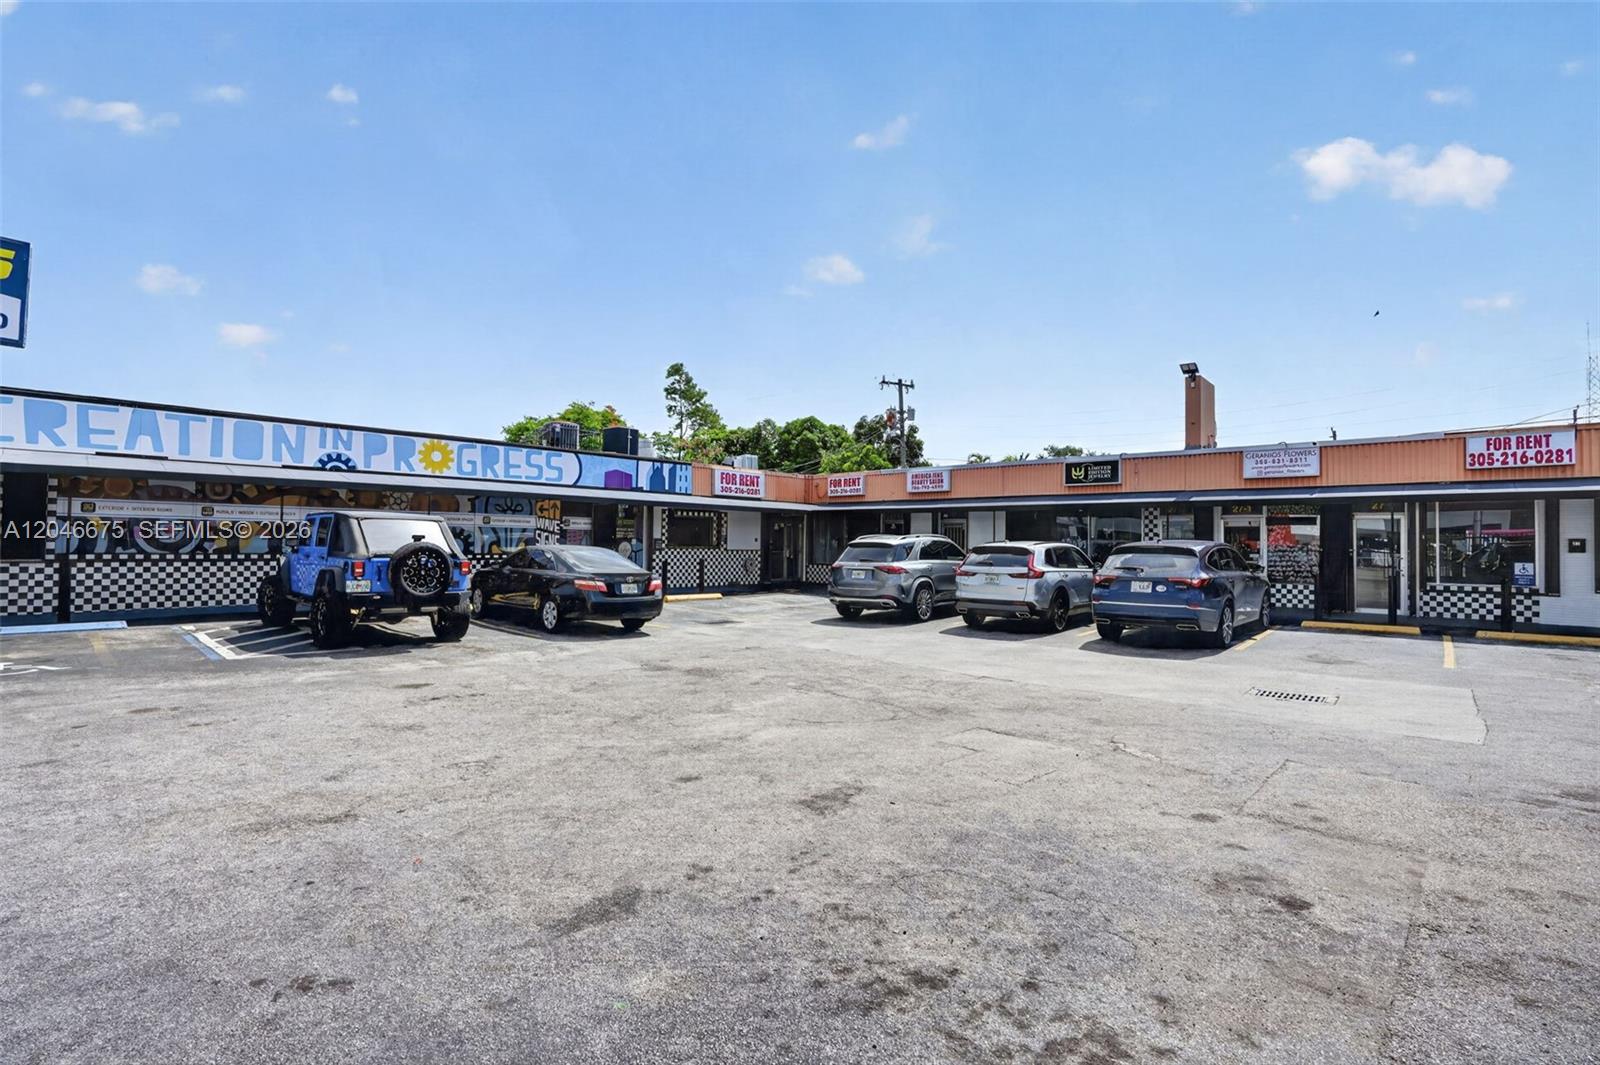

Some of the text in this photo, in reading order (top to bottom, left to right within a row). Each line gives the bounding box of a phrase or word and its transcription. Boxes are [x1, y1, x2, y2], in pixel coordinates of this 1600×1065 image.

[319, 427, 352, 450] IN
[1486, 433, 1552, 451] FOR RENT
[1283, 449, 1317, 457] FLOWERS
[1468, 448, 1573, 467] 305-216-0281
[720, 472, 760, 488] FOR RENT
[829, 477, 861, 488] FOR RENT
[720, 486, 760, 496] 305-216-0281
[536, 516, 561, 533] WAVE
